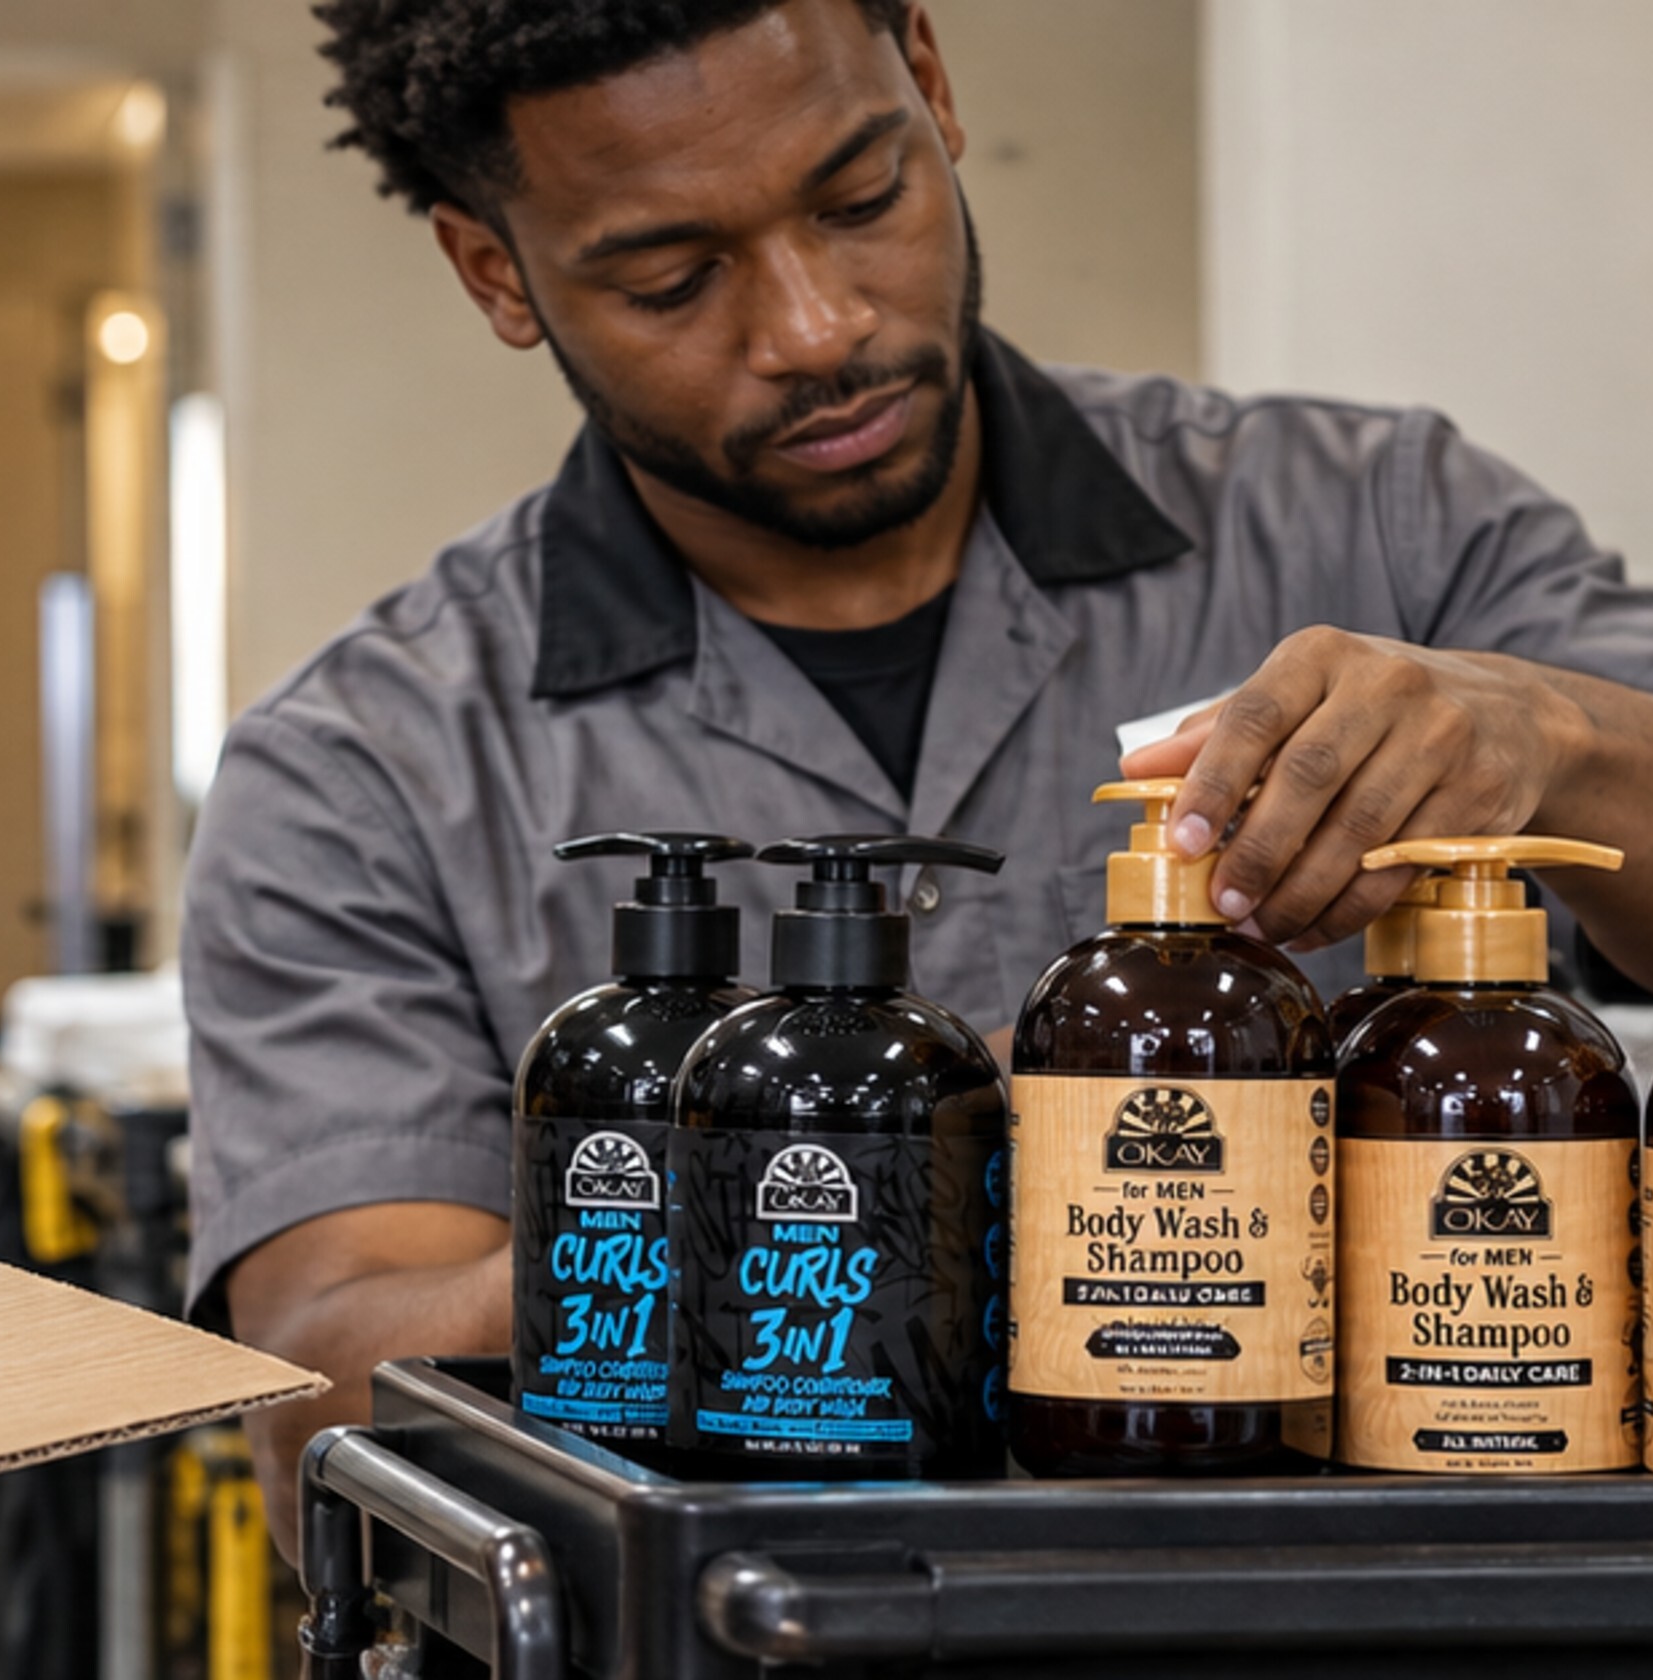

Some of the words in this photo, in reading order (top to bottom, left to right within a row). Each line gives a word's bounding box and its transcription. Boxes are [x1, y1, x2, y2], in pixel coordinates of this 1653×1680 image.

[1117, 1141, 1211, 1166] OKAY
[576, 1177, 645, 1198] OKAY
[1123, 1181, 1149, 1199] for
[1156, 1182, 1205, 1200] MEN
[580, 1210, 642, 1231] MEN
[1066, 1203, 1145, 1245] Body
[1154, 1205, 1240, 1240] Wash
[1248, 1207, 1269, 1239] &
[1444, 1207, 1539, 1231] OKAY
[773, 1224, 840, 1243] MEN
[552, 1232, 670, 1293] CURLS
[1087, 1241, 1244, 1281] Shampoo
[1449, 1248, 1478, 1266] for
[1484, 1248, 1533, 1266] MEN
[739, 1245, 879, 1308] CURLS
[1389, 1271, 1473, 1316] Body
[1481, 1273, 1567, 1309] Wash
[1575, 1273, 1594, 1307] &
[1413, 1312, 1571, 1358] Shampoo
[1463, 1365, 1523, 1383] DAILY
[1527, 1364, 1580, 1382] CARE
